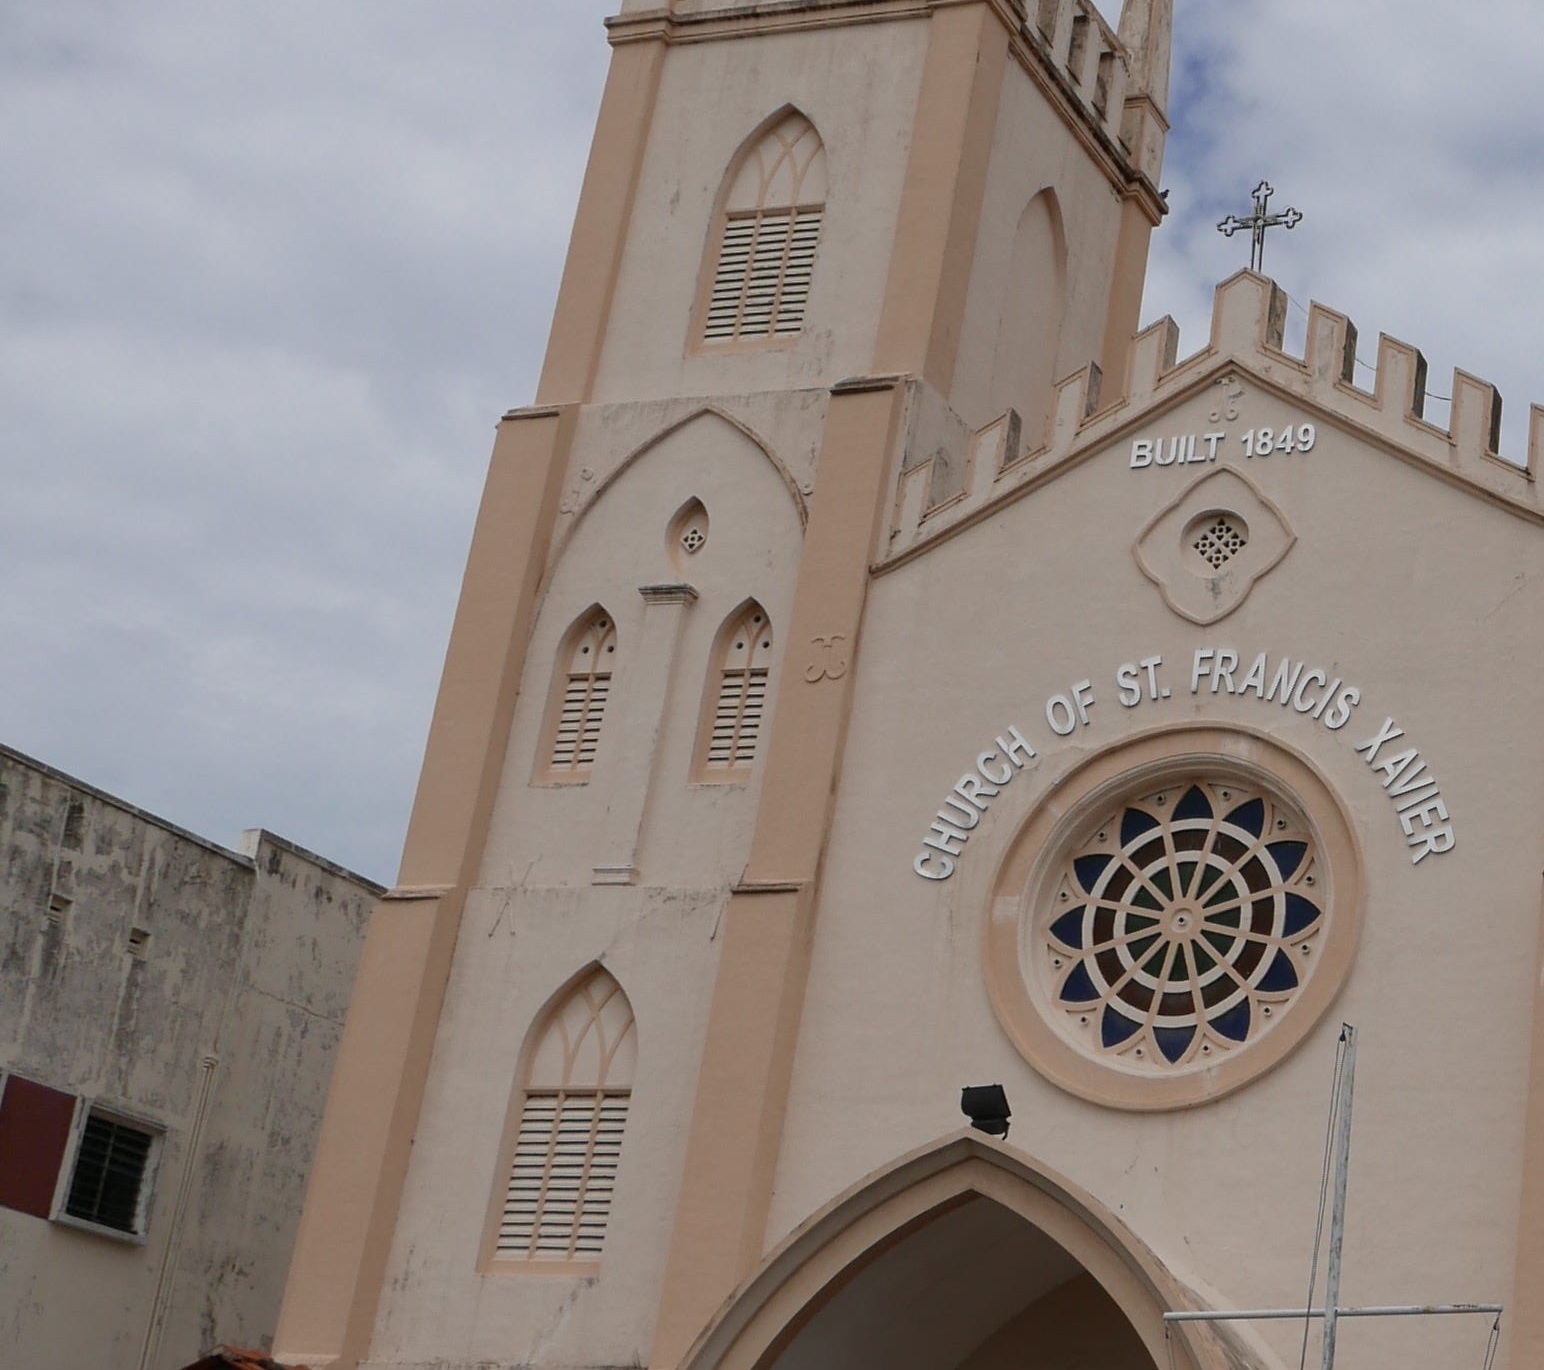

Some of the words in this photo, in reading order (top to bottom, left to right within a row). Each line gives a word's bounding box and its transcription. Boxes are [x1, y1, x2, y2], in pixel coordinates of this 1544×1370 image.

[1130, 432, 1225, 469] BUILT
[1241, 423, 1316, 459] 1849
[913, 725, 1036, 882] CHURCH
[1046, 679, 1096, 737] OF
[1117, 655, 1172, 708] ST.
[1191, 648, 1361, 730] FRANCIS
[1356, 717, 1456, 865] XAVIER
